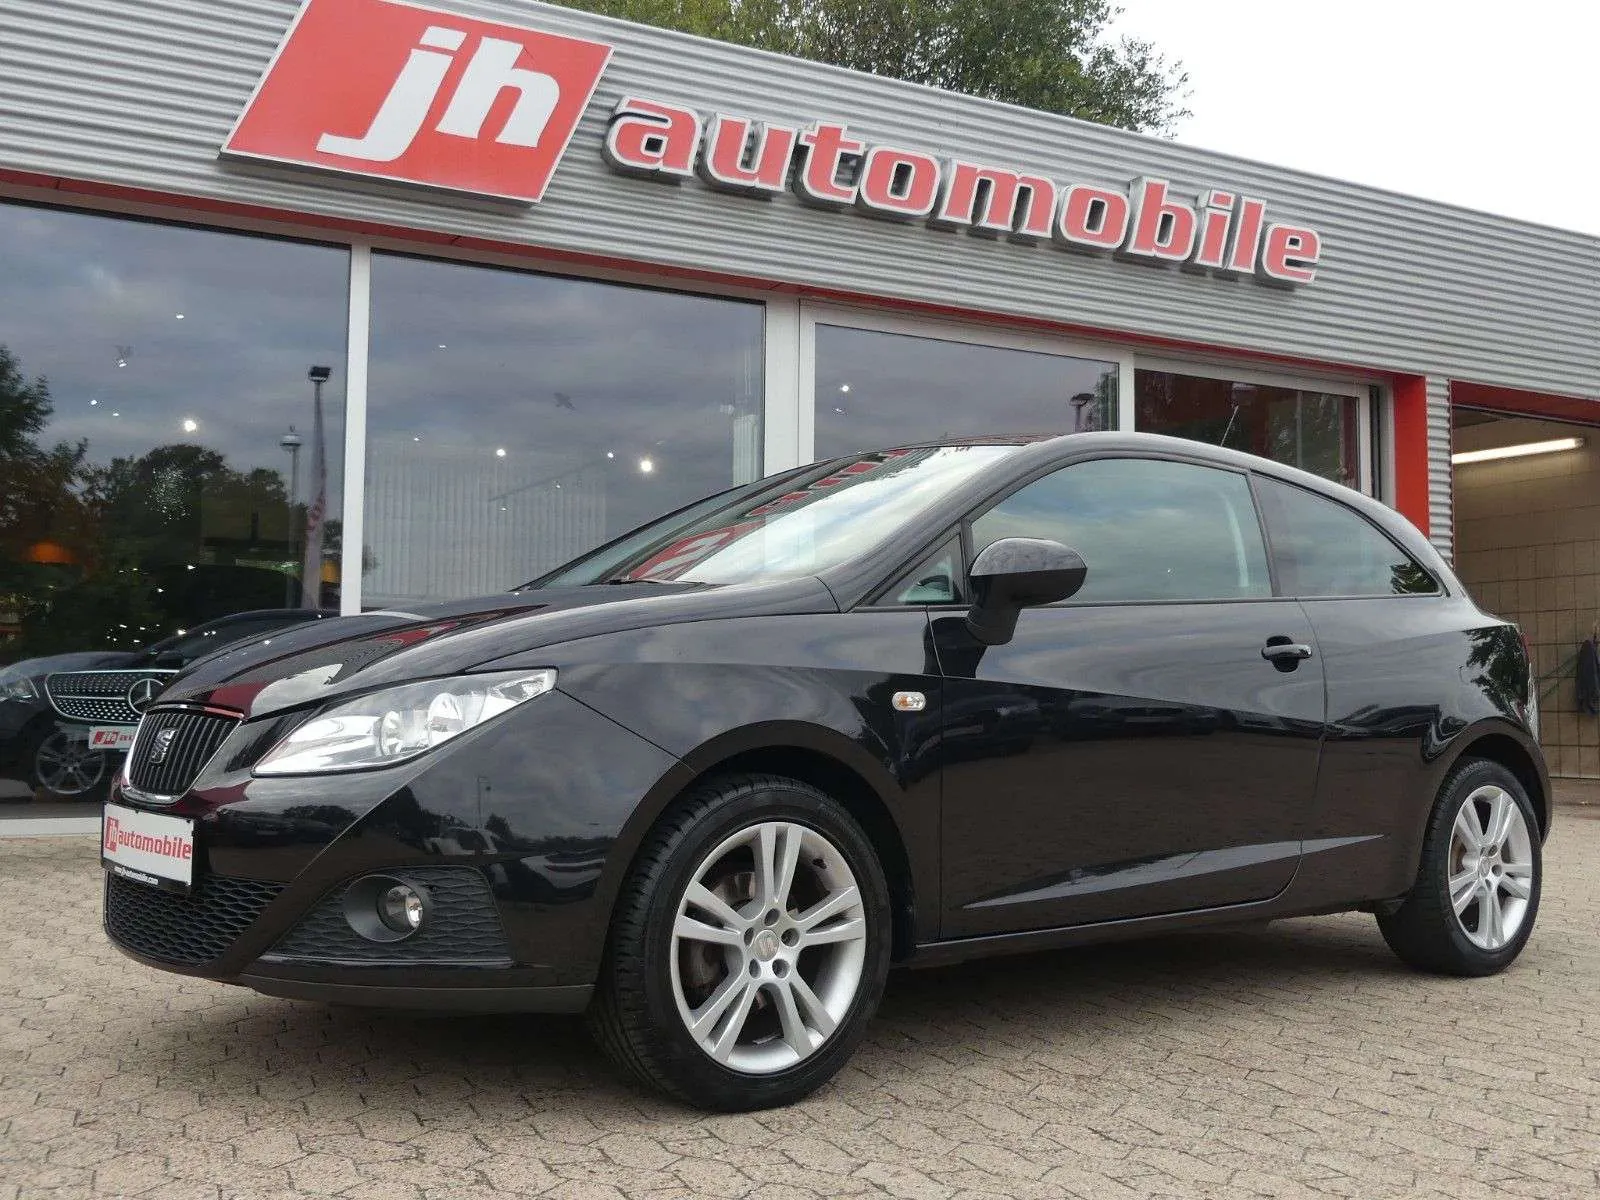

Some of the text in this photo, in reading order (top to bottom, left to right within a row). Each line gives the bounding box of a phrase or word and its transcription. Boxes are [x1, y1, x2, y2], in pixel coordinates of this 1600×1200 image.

[316, 26, 1322, 285] jh automobile
[118, 830, 192, 859] automobile
